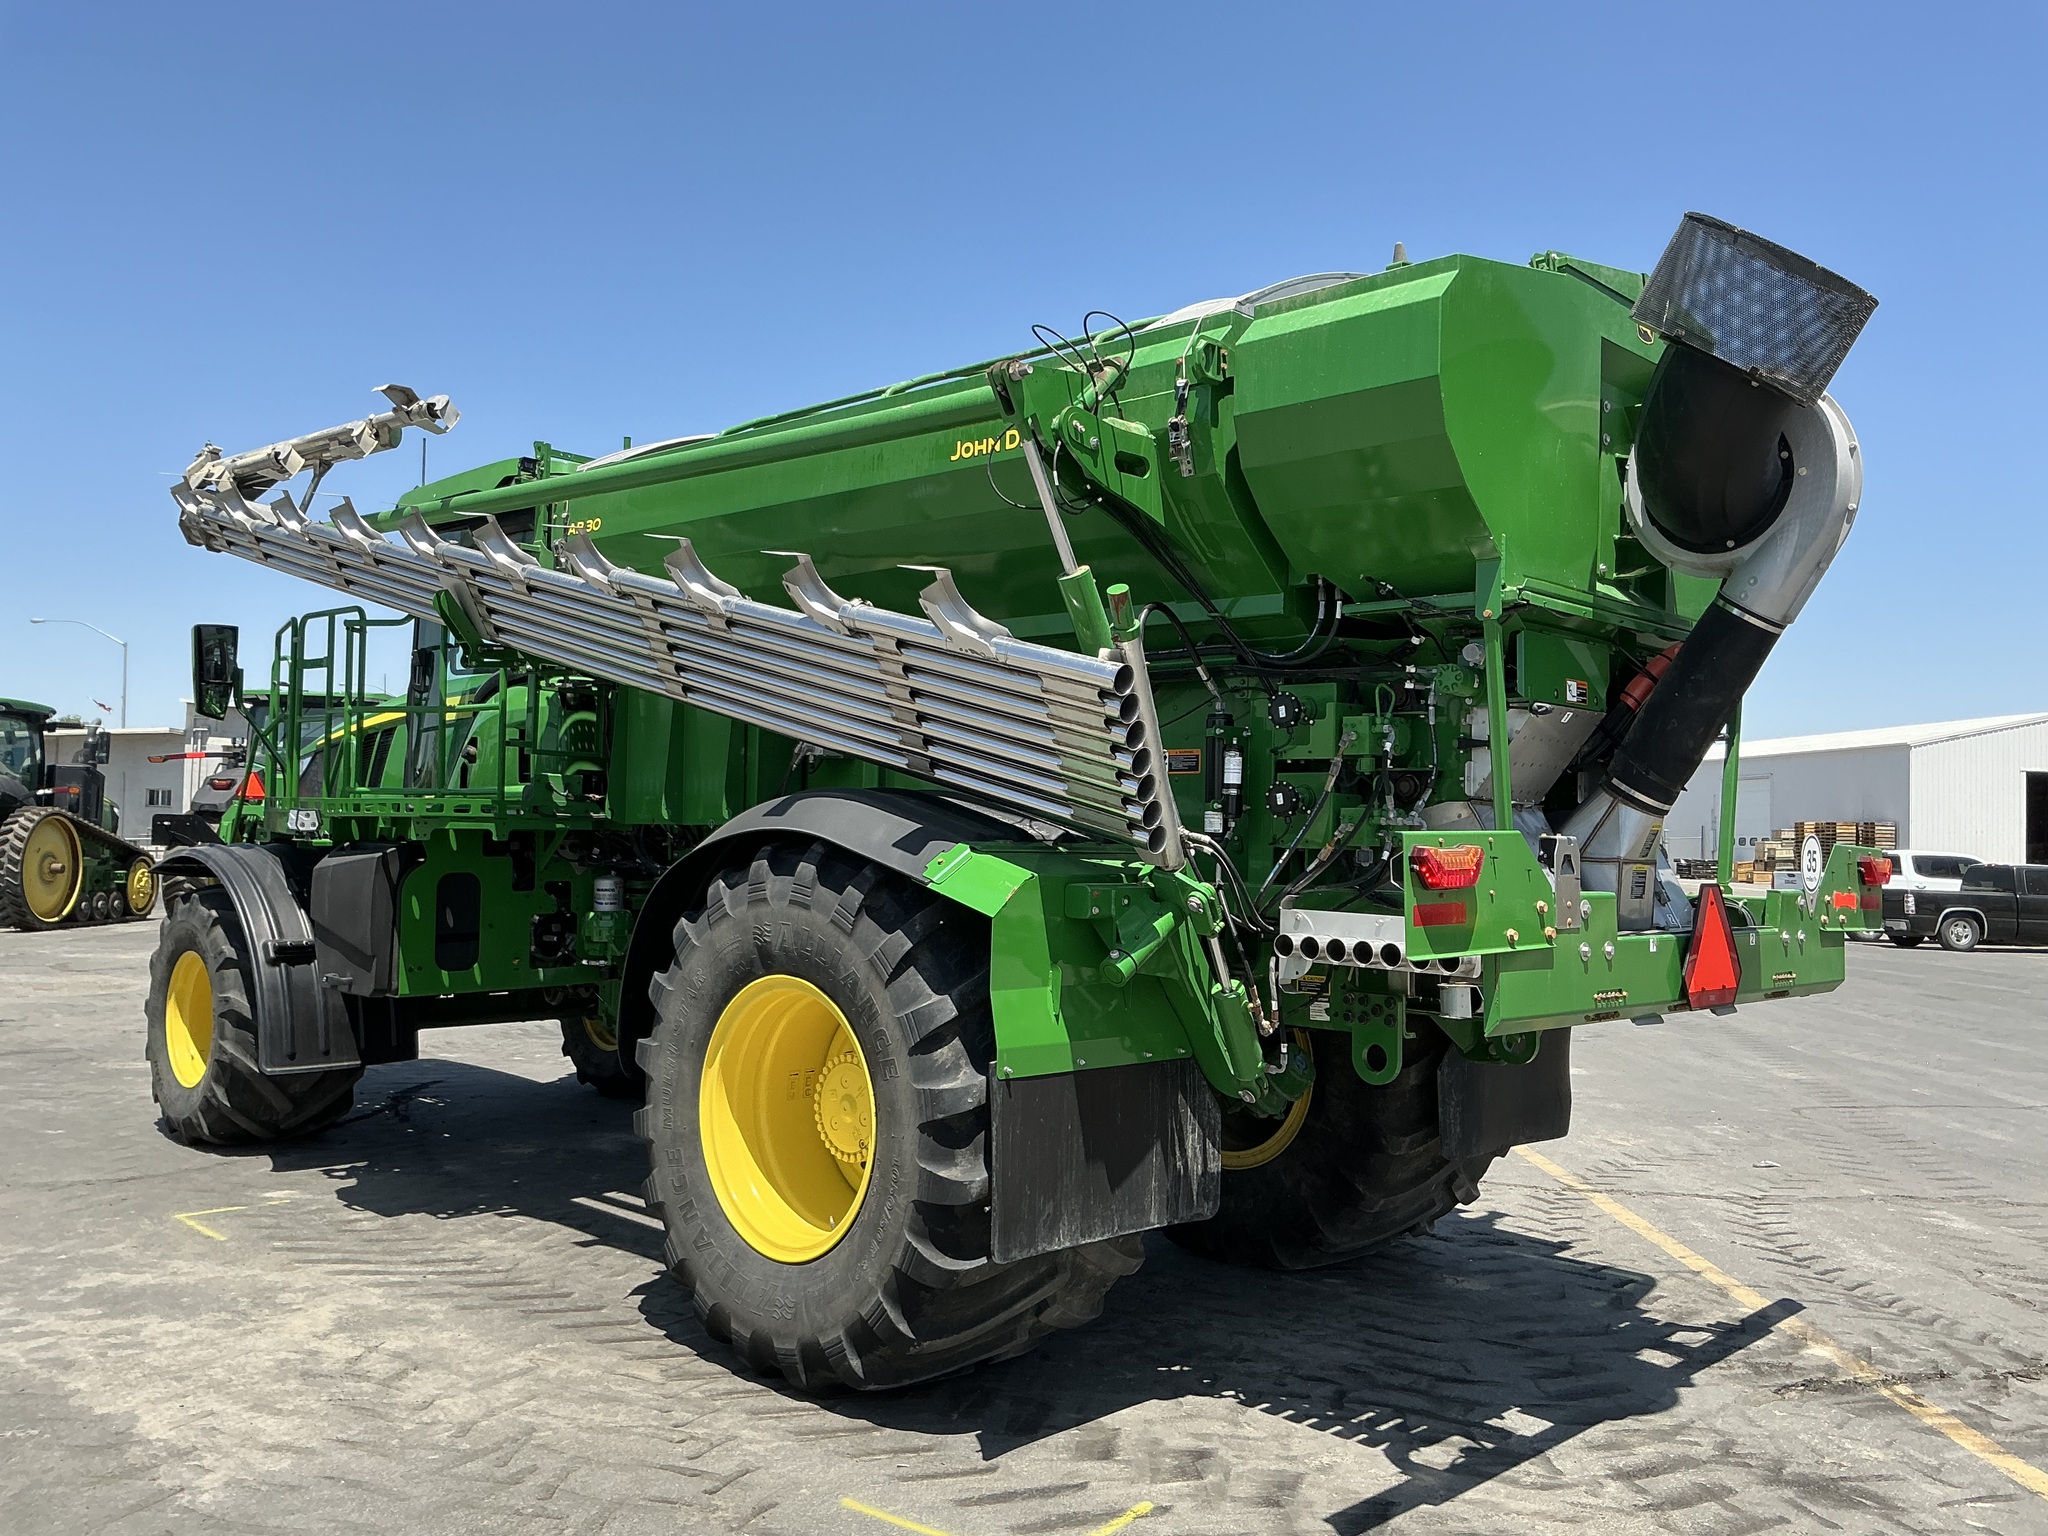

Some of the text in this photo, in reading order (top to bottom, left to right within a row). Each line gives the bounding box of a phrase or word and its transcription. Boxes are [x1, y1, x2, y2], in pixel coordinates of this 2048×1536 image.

[950, 436, 1001, 462] JOHN
[586, 517, 602, 533] 30
[1806, 849, 1817, 873] 35
[773, 920, 901, 1081] ALLIANCE
[665, 1147, 779, 1317] ALLIANCE
